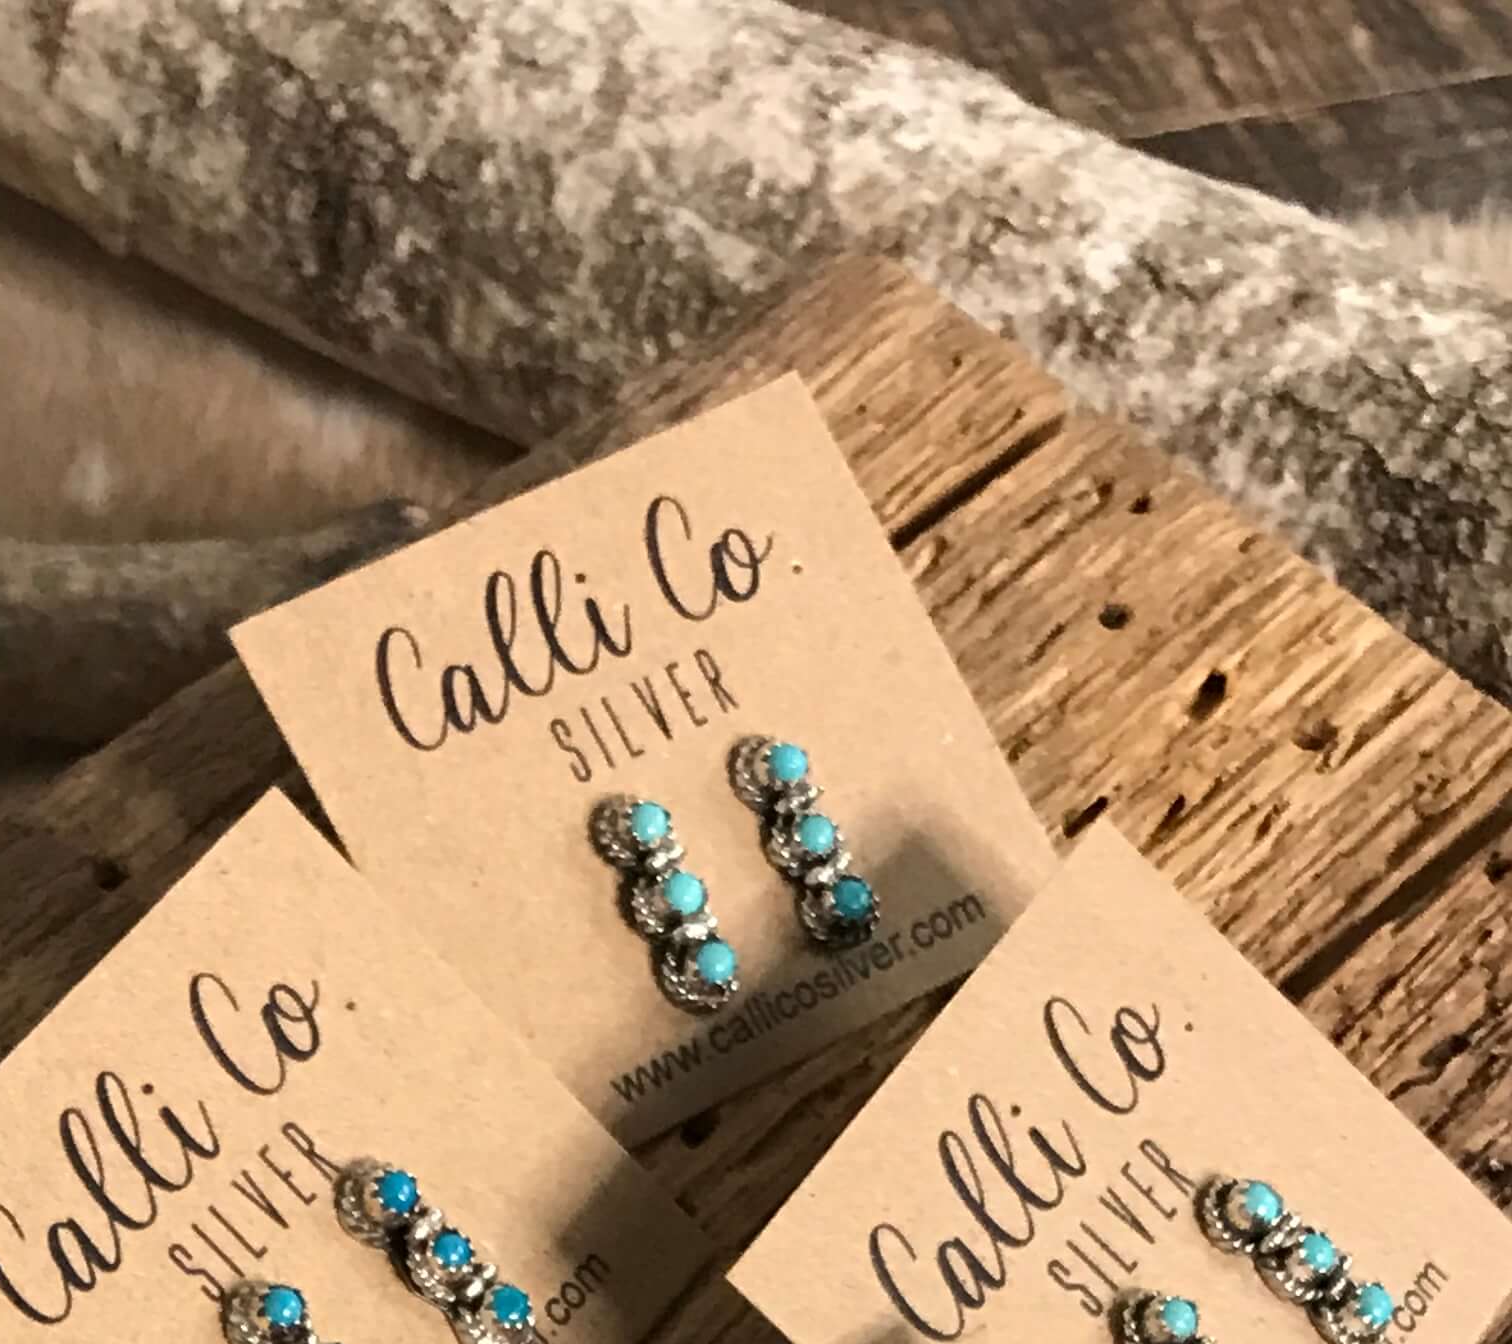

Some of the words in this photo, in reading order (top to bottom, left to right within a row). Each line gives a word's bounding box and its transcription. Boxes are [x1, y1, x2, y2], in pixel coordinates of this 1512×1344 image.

[375, 549, 632, 752] Calli
[550, 648, 740, 784] SILVER
[610, 887, 987, 1105] www.callicosilver.com
[168, 1121, 342, 1305] SILVER
[868, 1093, 1088, 1342] Calli
[1047, 1138, 1197, 1317] SILVER
